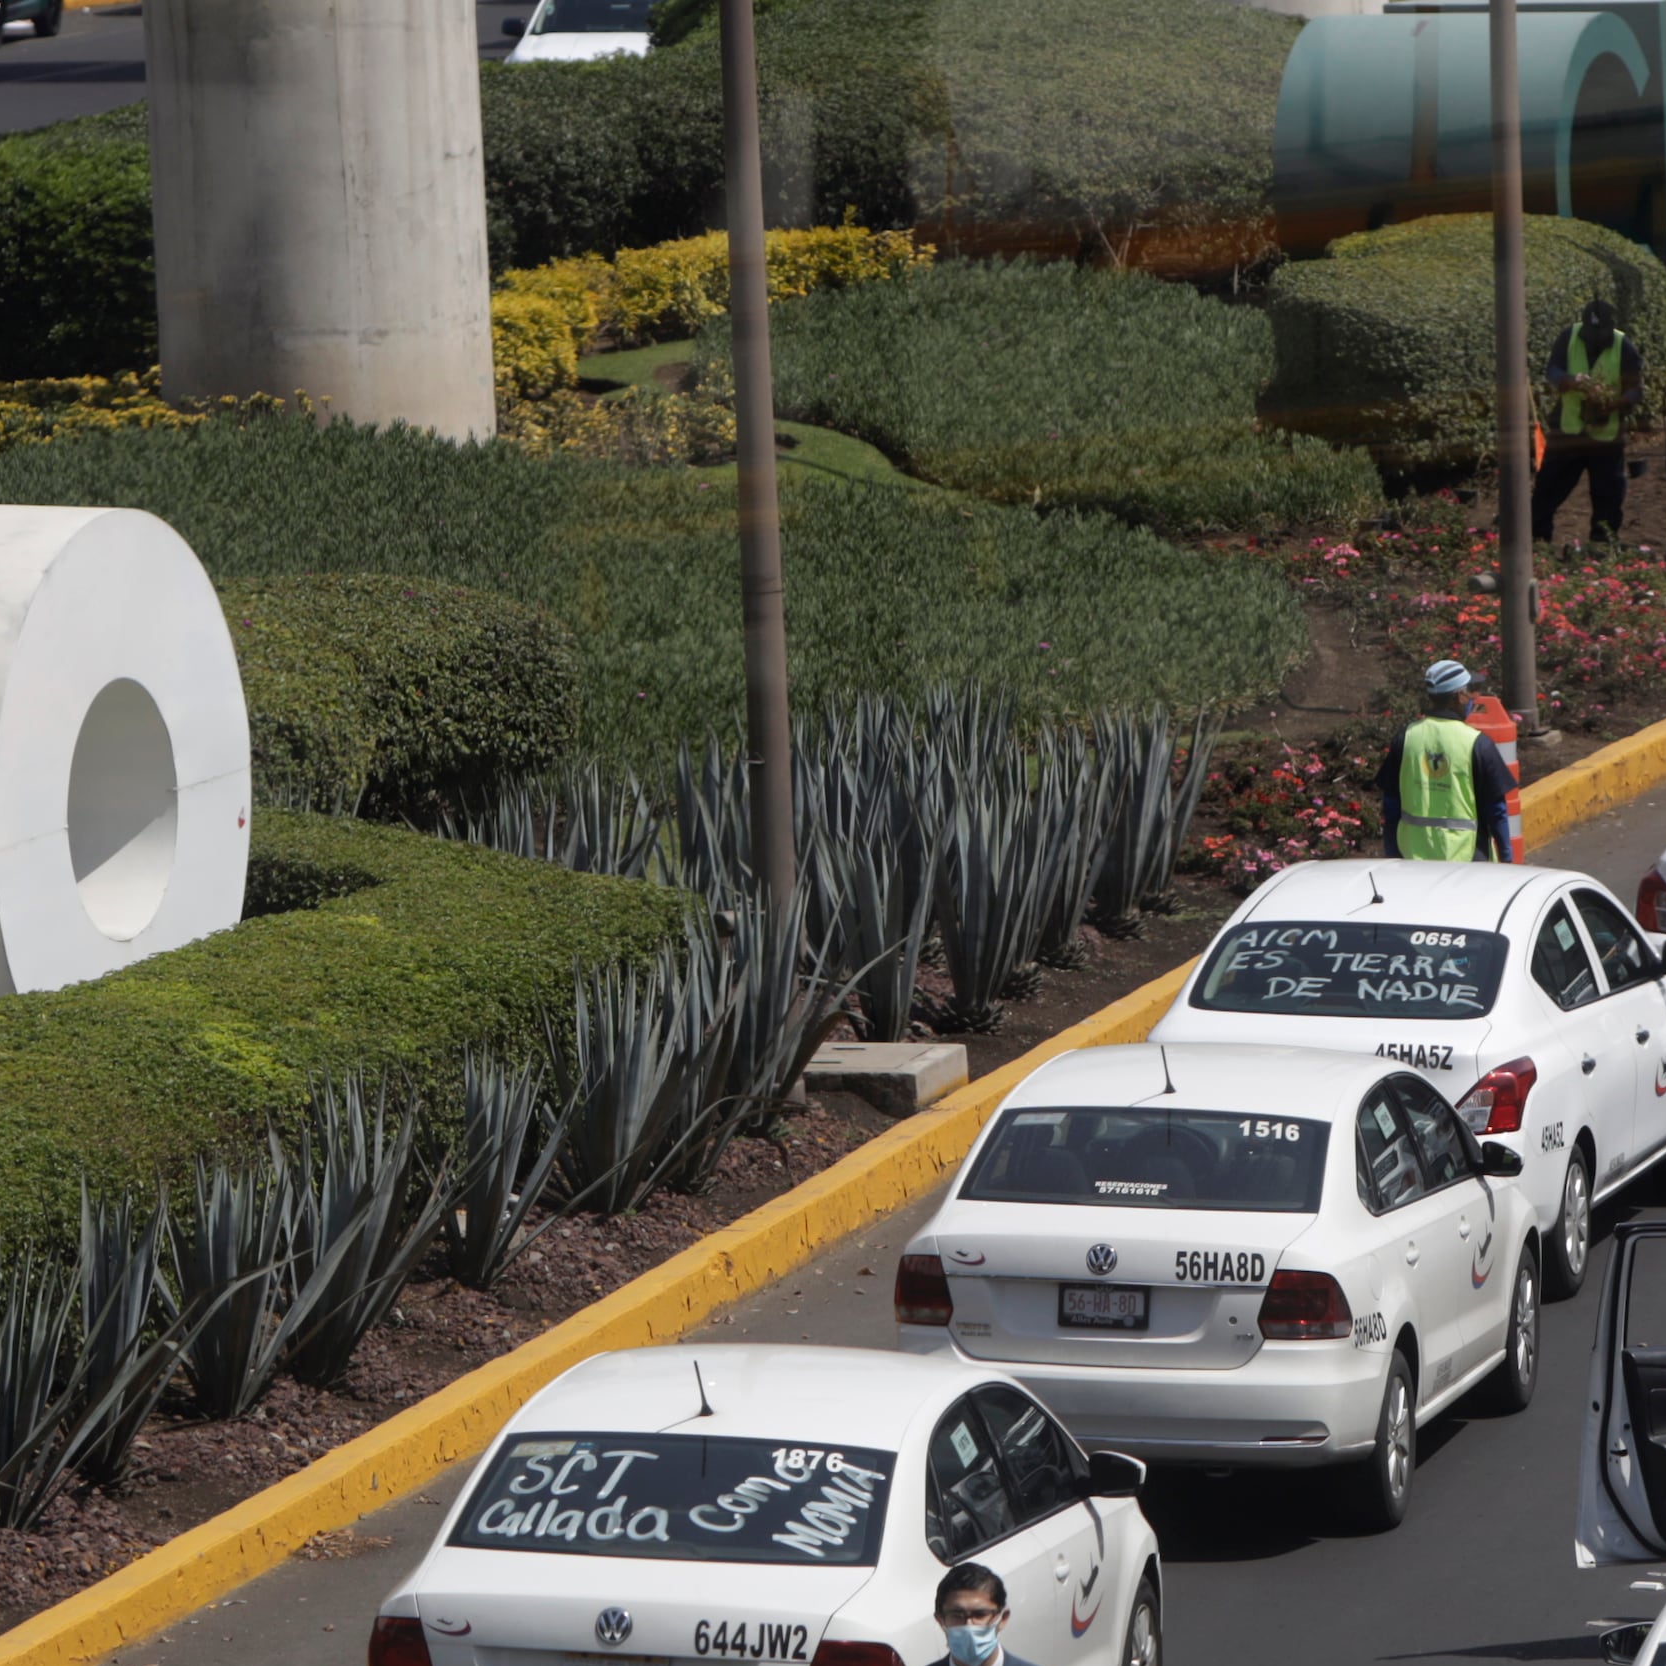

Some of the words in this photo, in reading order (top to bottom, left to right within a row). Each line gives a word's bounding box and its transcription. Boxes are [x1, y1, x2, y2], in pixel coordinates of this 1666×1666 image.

[1236, 928, 1338, 950] AICM
[1410, 931, 1466, 948] 0654
[1226, 950, 1290, 973] ES
[1323, 952, 1466, 978] TIERRA
[1262, 977, 1332, 999] DE
[1358, 978, 1485, 1010] NADIE
[1375, 1043, 1454, 1070] 45HA5Z
[1238, 1120, 1300, 1142] 1516
[1175, 1251, 1265, 1282] 56HA8D
[509, 1448, 660, 1499] SCT
[772, 1448, 845, 1473] 1876
[477, 1495, 670, 1543] Callada
[694, 1620, 808, 1661] 644JW2
